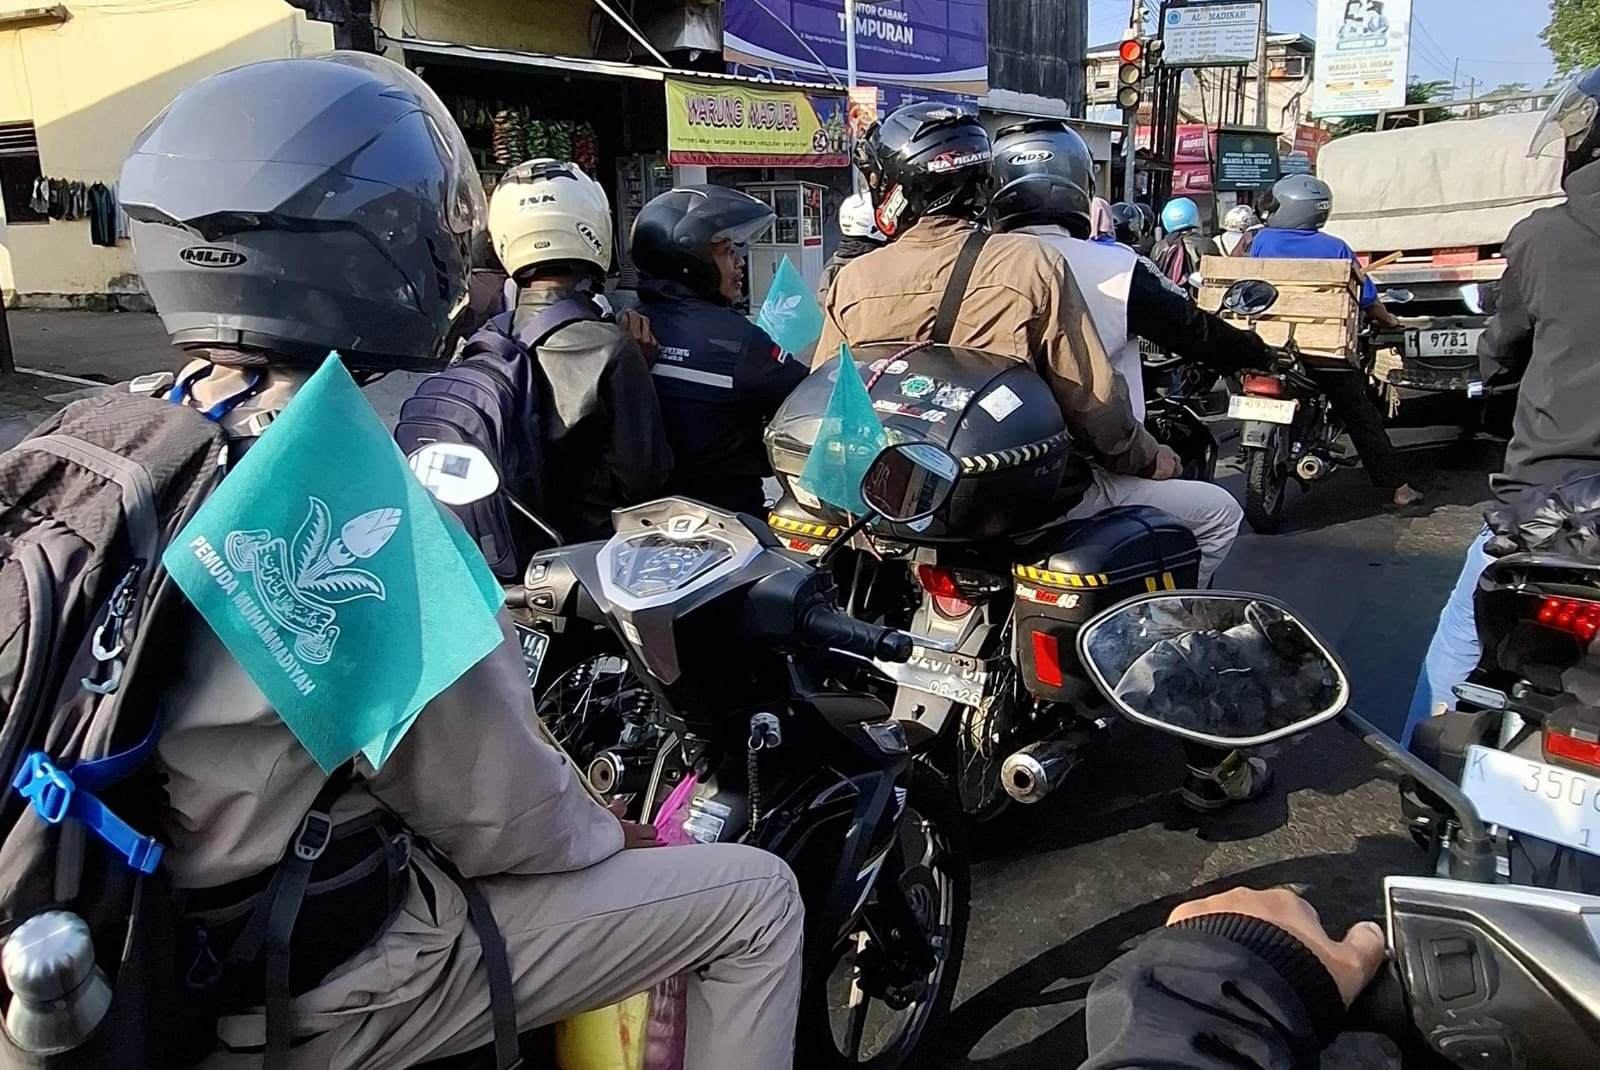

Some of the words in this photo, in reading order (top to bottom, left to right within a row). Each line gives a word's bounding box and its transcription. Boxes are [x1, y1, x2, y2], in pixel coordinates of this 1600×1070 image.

[877, 7, 908, 22] CABANG
[837, 12, 914, 46] TMPURAN
[685, 94, 744, 128] WARUNG
[748, 100, 800, 131] MADURA
[814, 134, 828, 147] 24
[1017, 153, 1046, 162] MDS
[519, 194, 556, 206] INK
[580, 226, 602, 251] INK
[1408, 334, 1417, 348] H
[1430, 332, 1468, 348] 9781
[189, 535, 240, 596] PEMUDA
[232, 590, 317, 697] MUHAMMADIYAH
[1472, 750, 1488, 782] K
